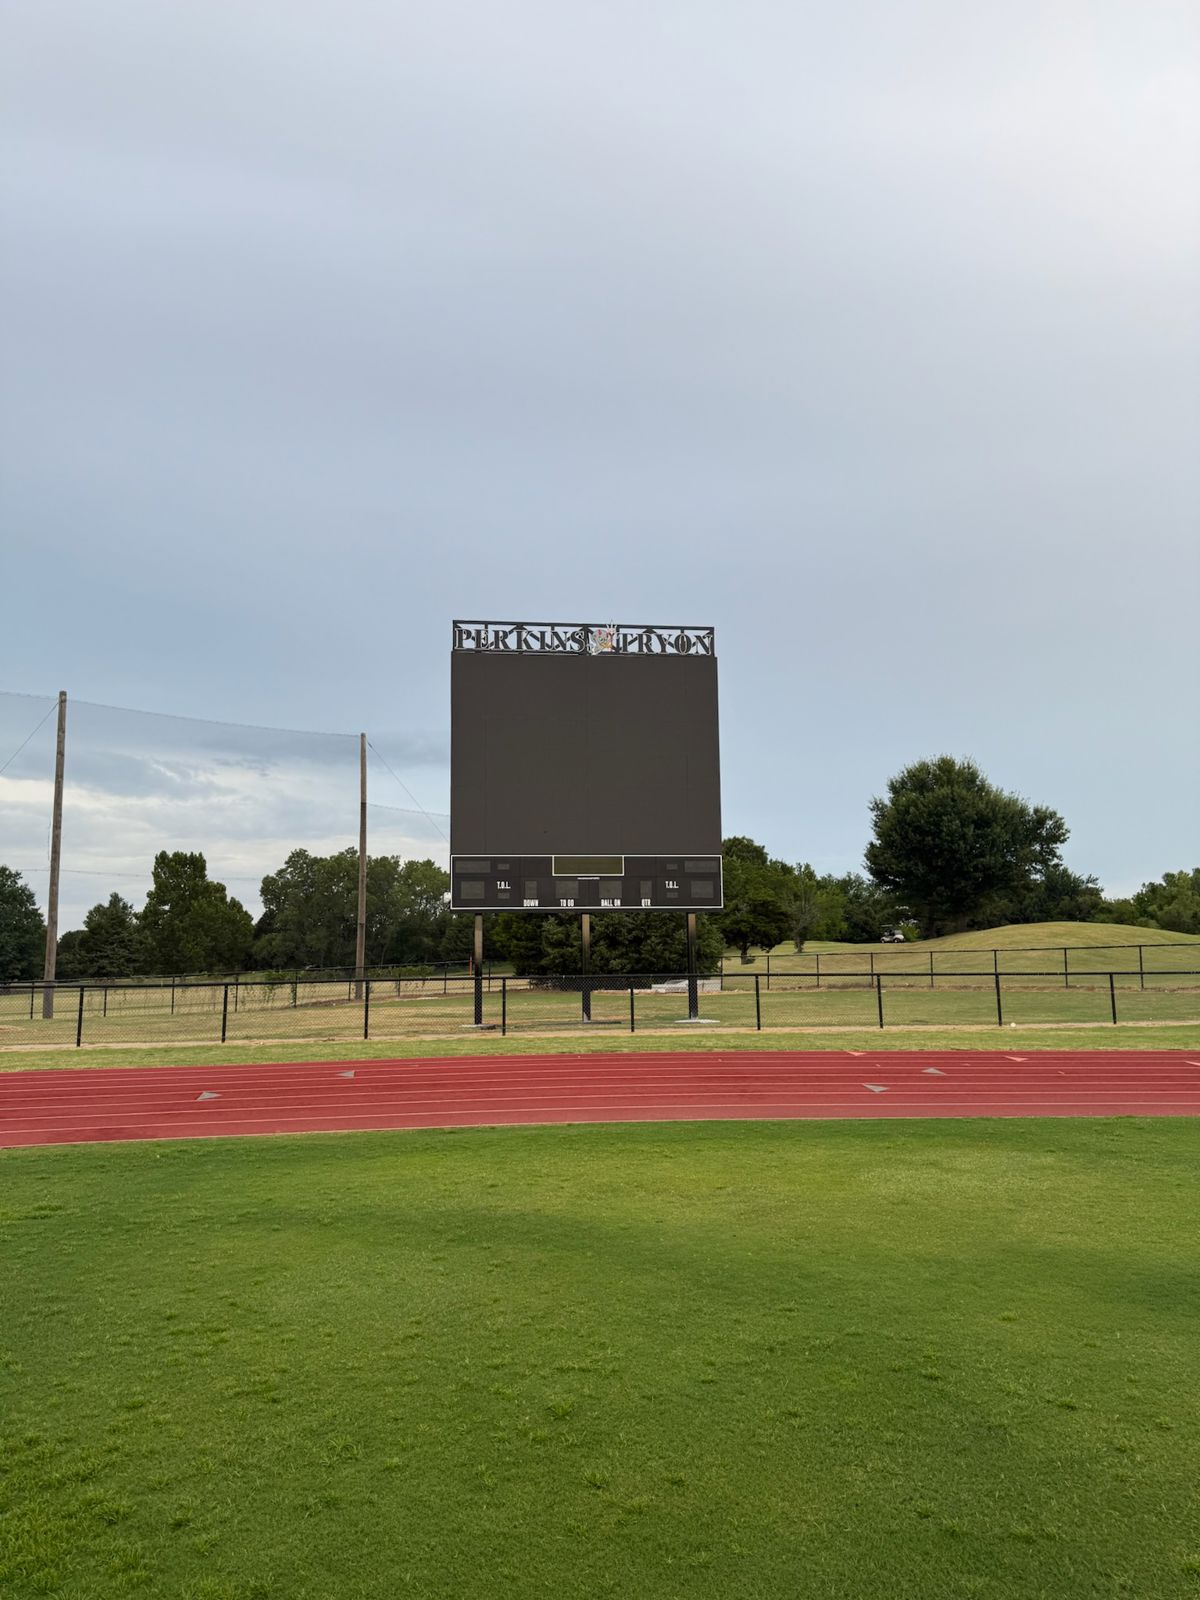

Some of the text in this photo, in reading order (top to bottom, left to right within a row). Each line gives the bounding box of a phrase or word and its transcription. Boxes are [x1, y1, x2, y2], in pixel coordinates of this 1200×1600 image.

[454, 628, 713, 656] PERKINS TRYON
[523, 899, 539, 907] DOWN
[560, 899, 575, 907] TO GO
[601, 899, 621, 907] BALL ON
[641, 899, 651, 907] QTR
